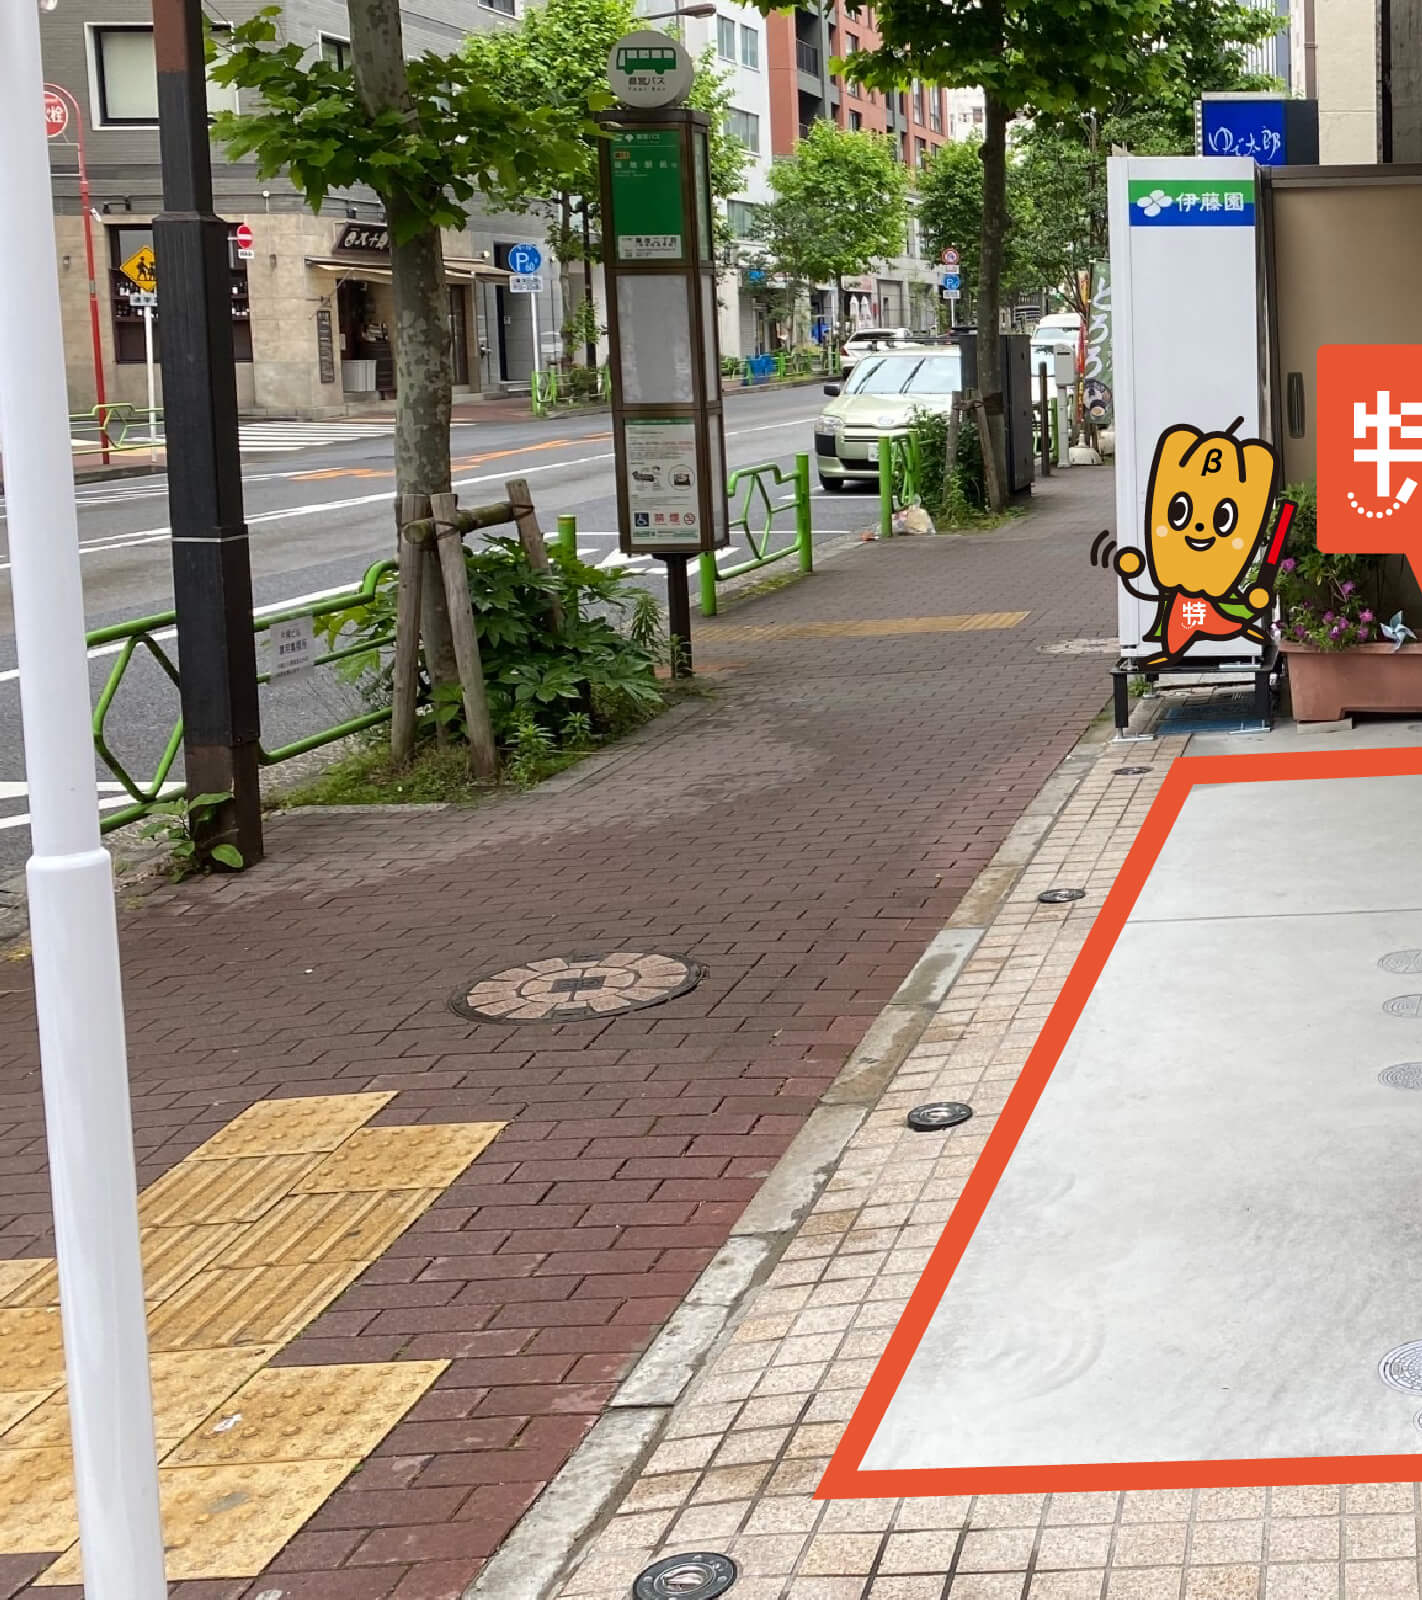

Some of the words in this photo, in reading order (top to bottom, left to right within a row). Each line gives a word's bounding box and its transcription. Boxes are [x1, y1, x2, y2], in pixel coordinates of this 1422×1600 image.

[1176, 192, 1244, 212] 伊藤園
[1084, 276, 1113, 380] とろろ
